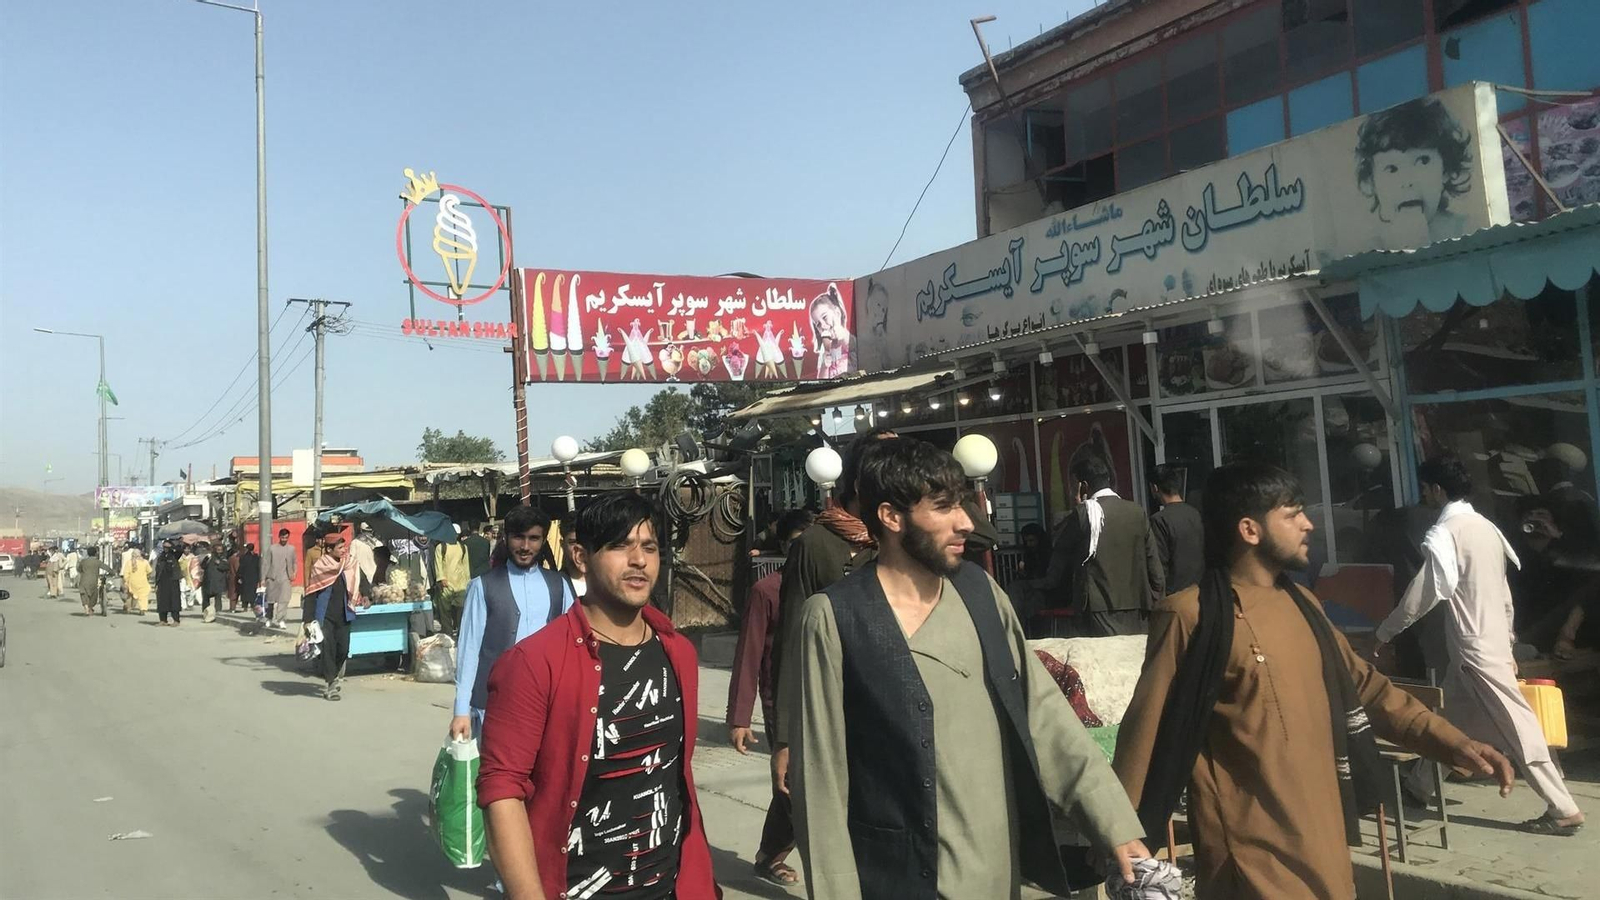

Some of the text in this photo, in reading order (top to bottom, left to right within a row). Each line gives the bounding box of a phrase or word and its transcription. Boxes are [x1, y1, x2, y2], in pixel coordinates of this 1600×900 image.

[916, 163, 1304, 322] سلطان شهر سوپر آیسکریم
[585, 282, 806, 316] سلطان شهر سوپر آیسکریم
[402, 318, 518, 338] SULTAN SHAR
